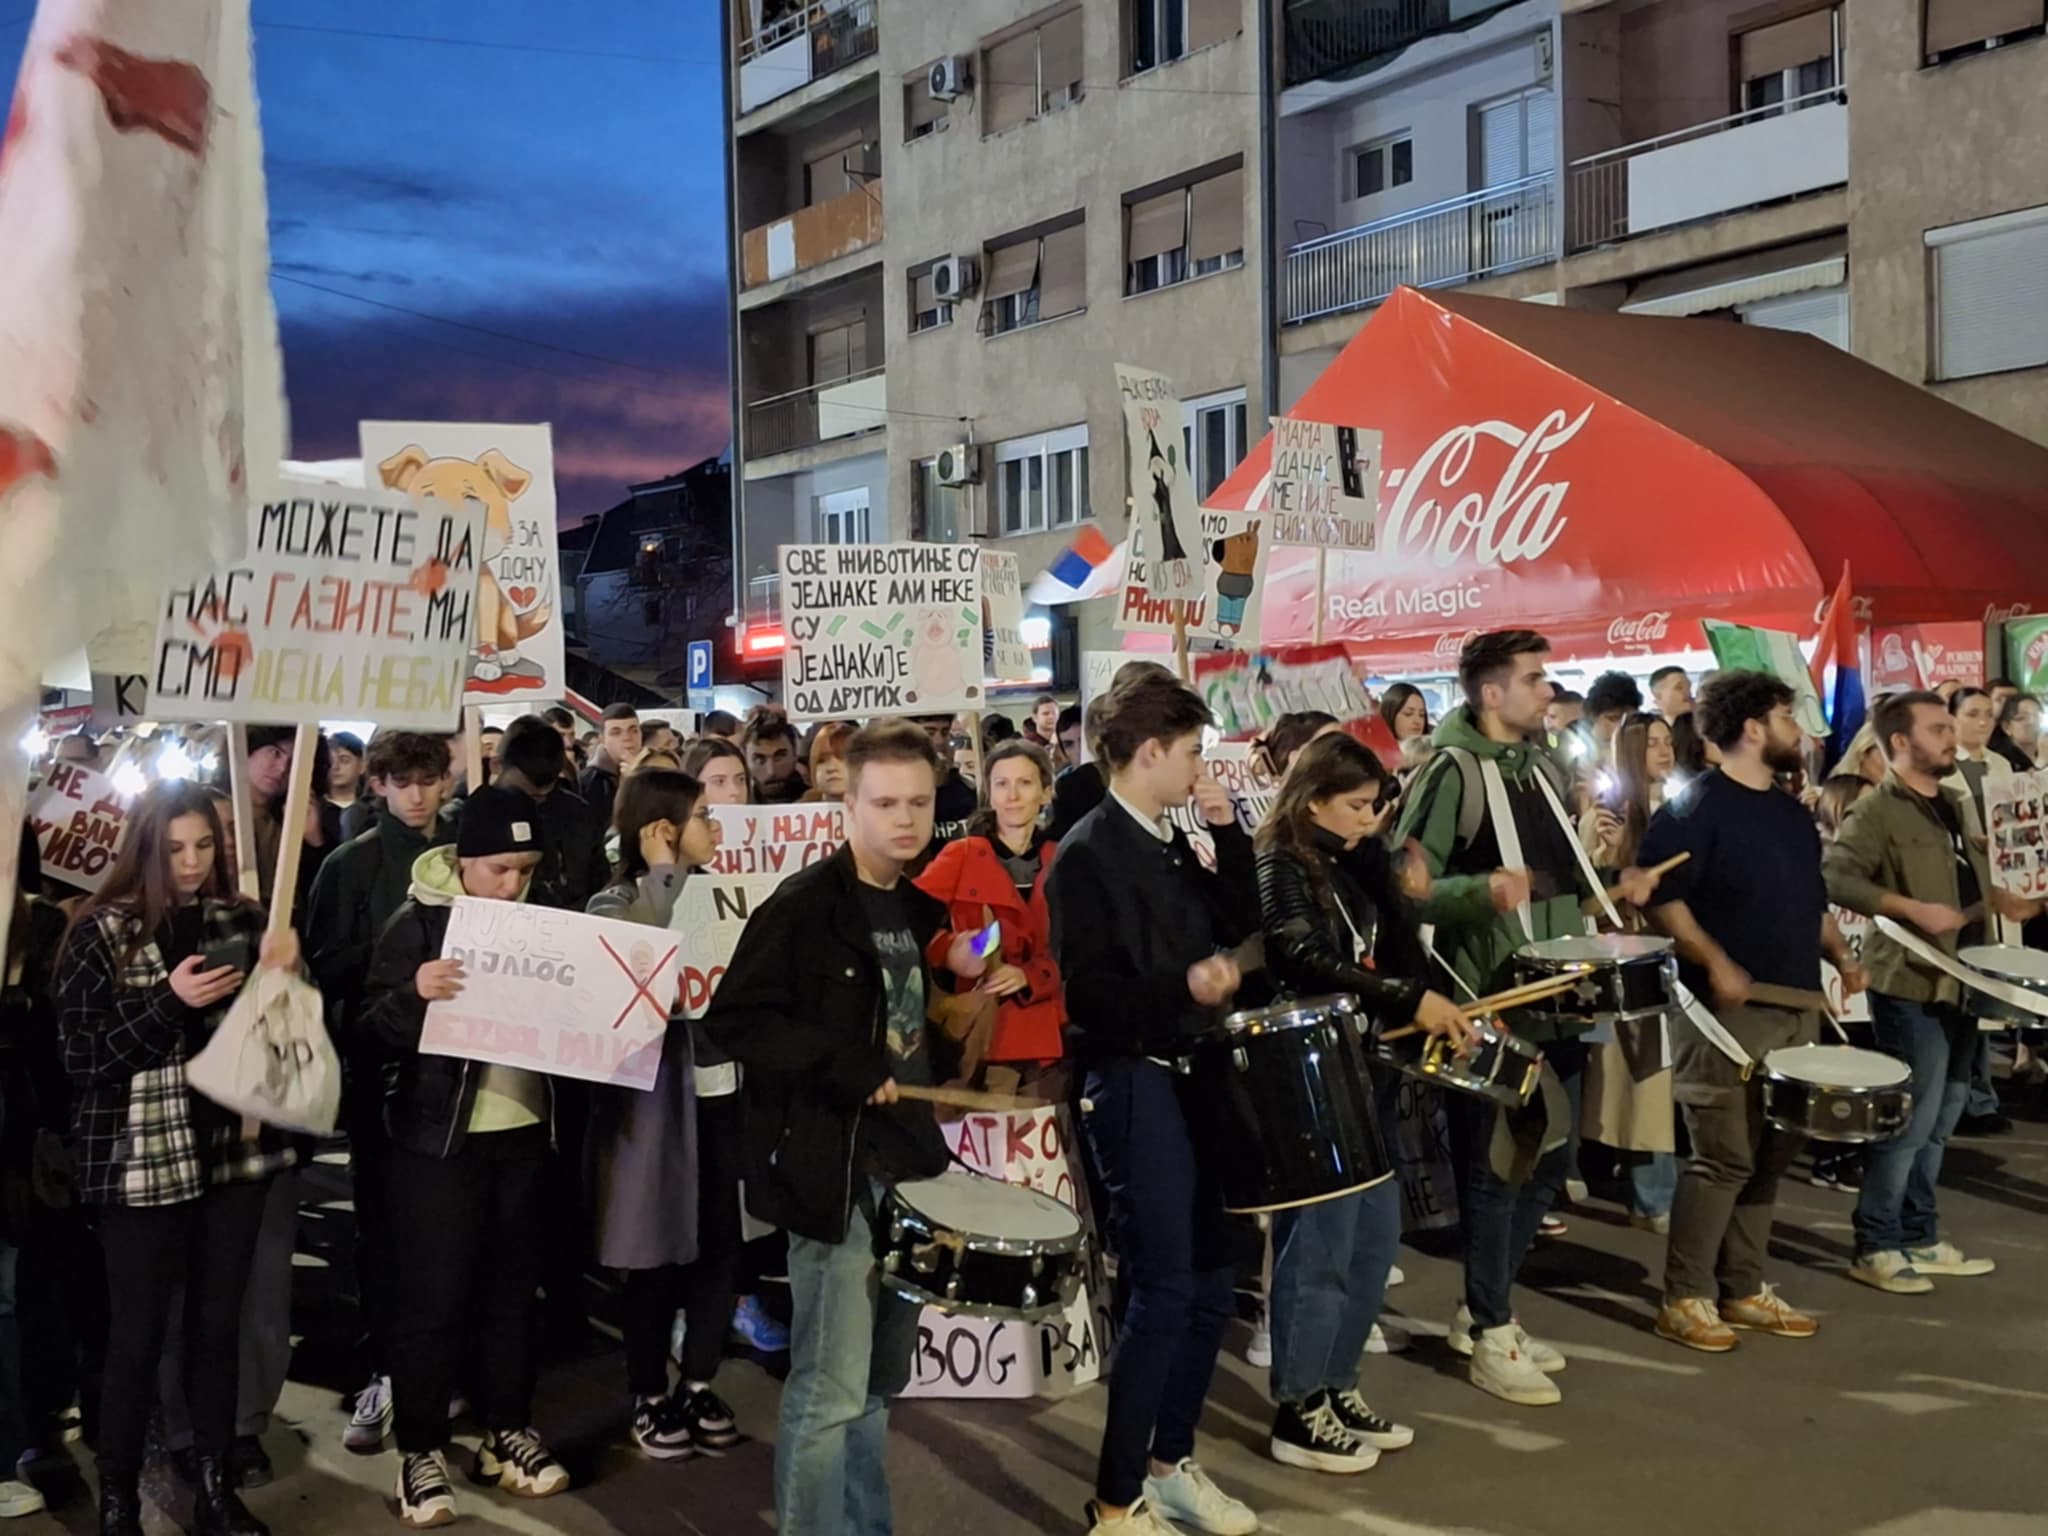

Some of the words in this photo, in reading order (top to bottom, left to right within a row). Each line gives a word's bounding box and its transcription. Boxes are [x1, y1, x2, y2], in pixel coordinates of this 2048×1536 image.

[1277, 420, 1322, 450] МАМА
[1271, 480, 1295, 512] МЕ
[256, 498, 419, 567] МОЖЕТЕ
[433, 513, 474, 572] ДА
[785, 549, 829, 576] СВЕ
[837, 547, 953, 576] ЖИВОТИЊЕ
[957, 547, 980, 574] СУ
[790, 579, 879, 610] ЈЕДНАКЕ
[887, 578, 926, 605] АЛИ
[931, 578, 976, 603] НЕКЕ
[1327, 592, 1388, 620] Real
[423, 588, 470, 643] МИ
[790, 615, 821, 641] СУ
[155, 638, 243, 701] СМО
[692, 648, 707, 685] P
[790, 642, 910, 687] ЈЕДНАКИЈЕ
[794, 689, 825, 713] ОД
[828, 684, 903, 714] ДРУГИХ
[47, 762, 90, 801] НЕ
[69, 809, 121, 848] ВАМ
